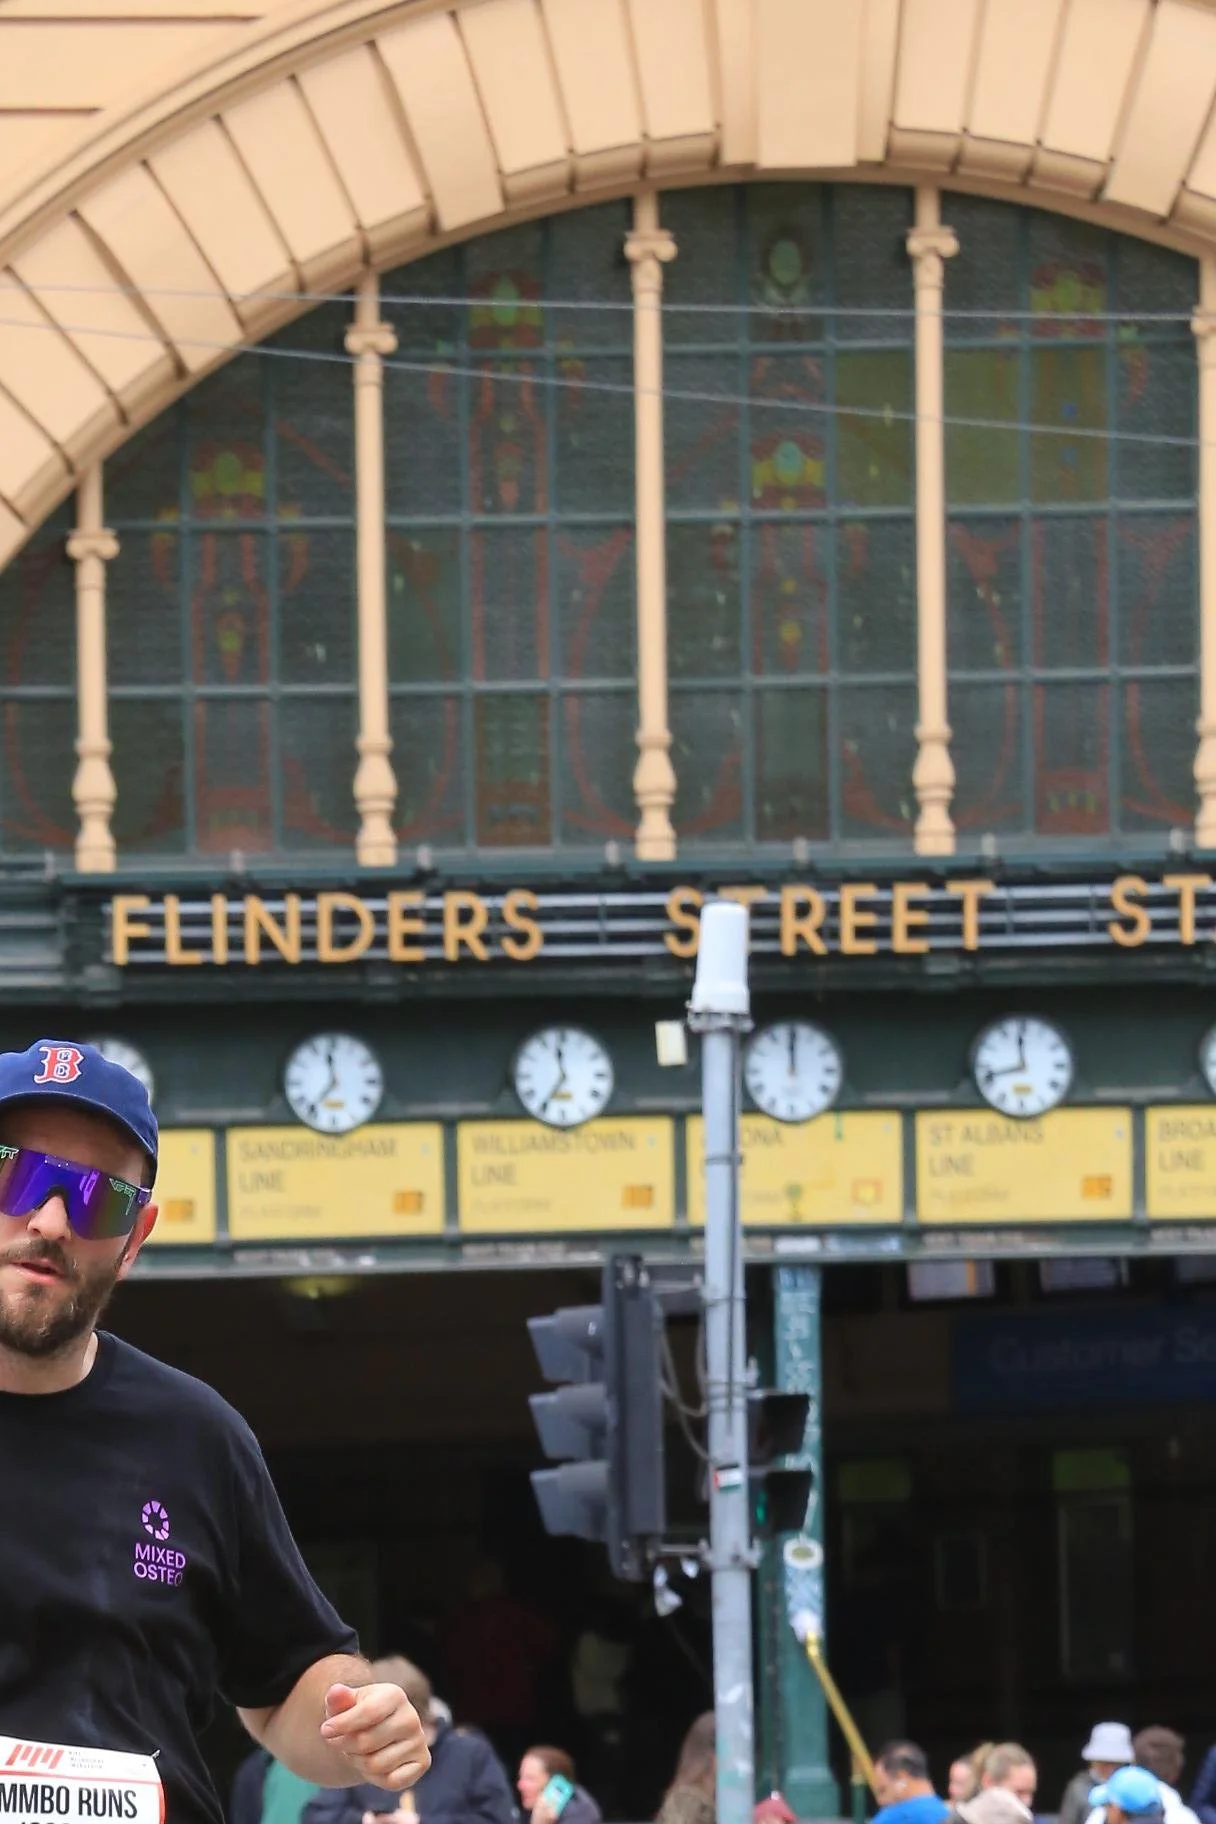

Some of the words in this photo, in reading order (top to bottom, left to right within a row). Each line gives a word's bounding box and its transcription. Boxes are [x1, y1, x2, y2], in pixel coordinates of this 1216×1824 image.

[110, 889, 544, 965] FLINDERS
[663, 879, 997, 958] STREET
[1108, 873, 1216, 948] ST
[34, 1046, 84, 1084] B
[135, 1543, 186, 1569] MIXED
[134, 1562, 183, 1587] OSTEO
[78, 1787, 138, 1818] RUNS
